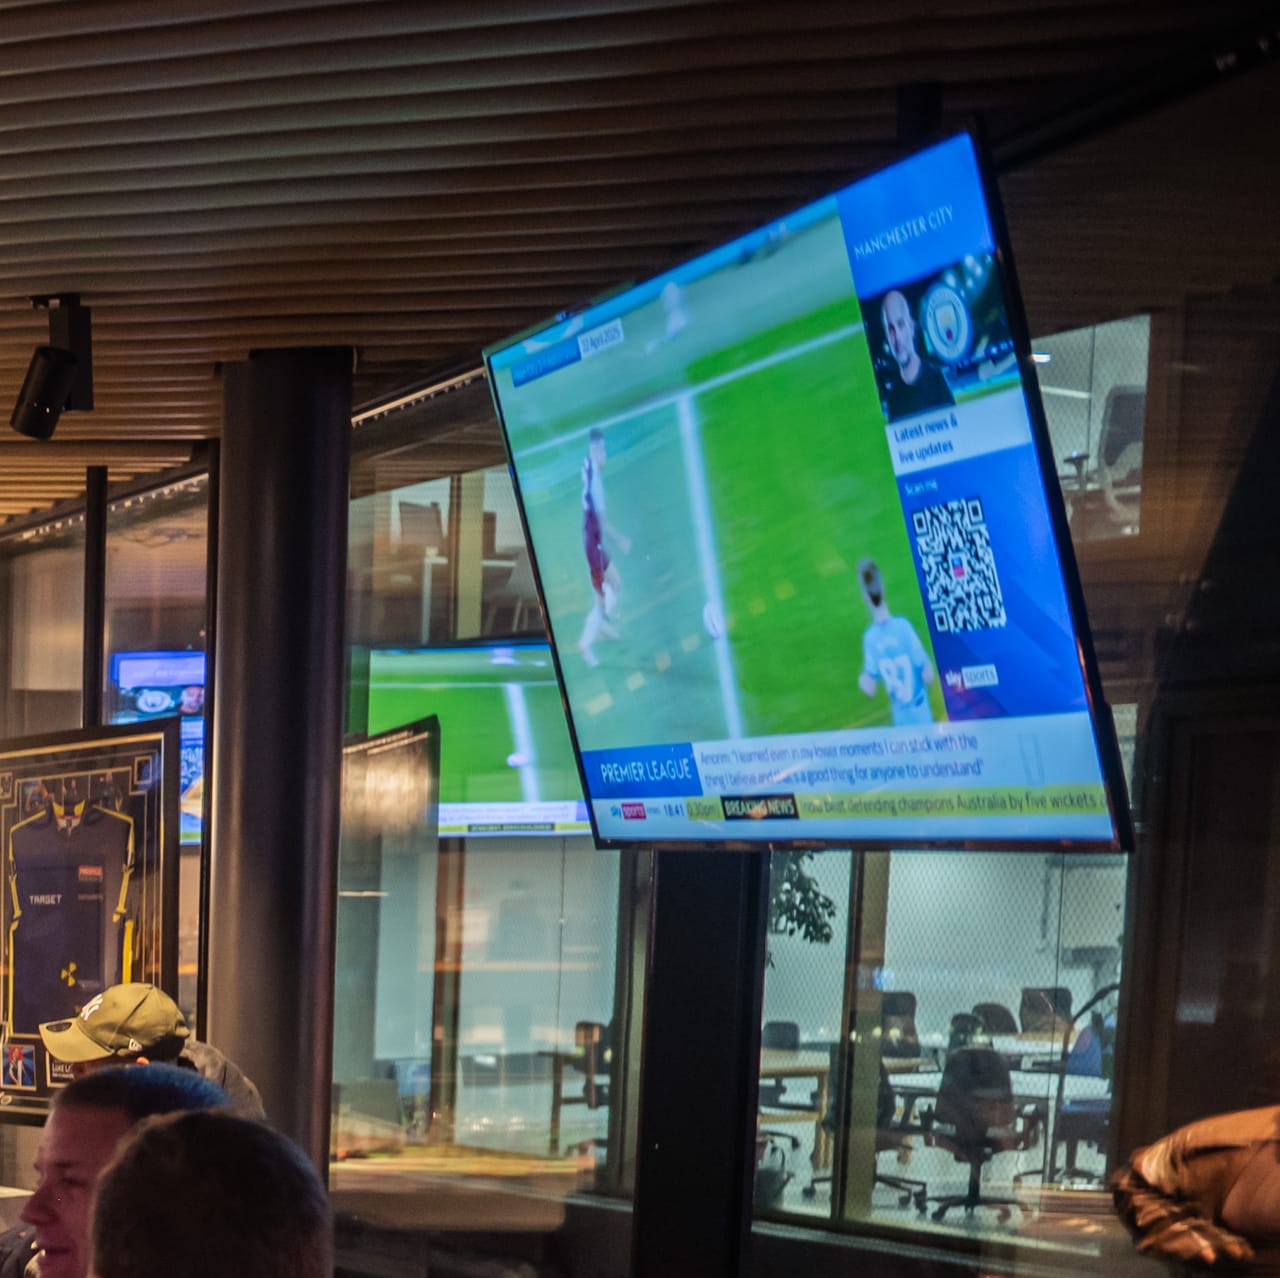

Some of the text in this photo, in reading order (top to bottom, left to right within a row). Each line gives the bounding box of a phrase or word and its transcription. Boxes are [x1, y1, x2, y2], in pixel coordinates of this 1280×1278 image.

[854, 204, 953, 261] MANCHESTER CITY
[894, 424, 924, 442] Latest
[925, 418, 949, 434] news
[899, 440, 953, 464] live updates
[945, 665, 996, 688] sky sports
[957, 732, 979, 749] the
[600, 757, 692, 784] PREMIER LEAGUE
[723, 797, 795, 816] BREAKING NEWS
[954, 794, 1008, 810] Australia
[1023, 791, 1048, 808] five
[1049, 791, 1097, 808] wickets
[29, 894, 62, 905] TARGET
